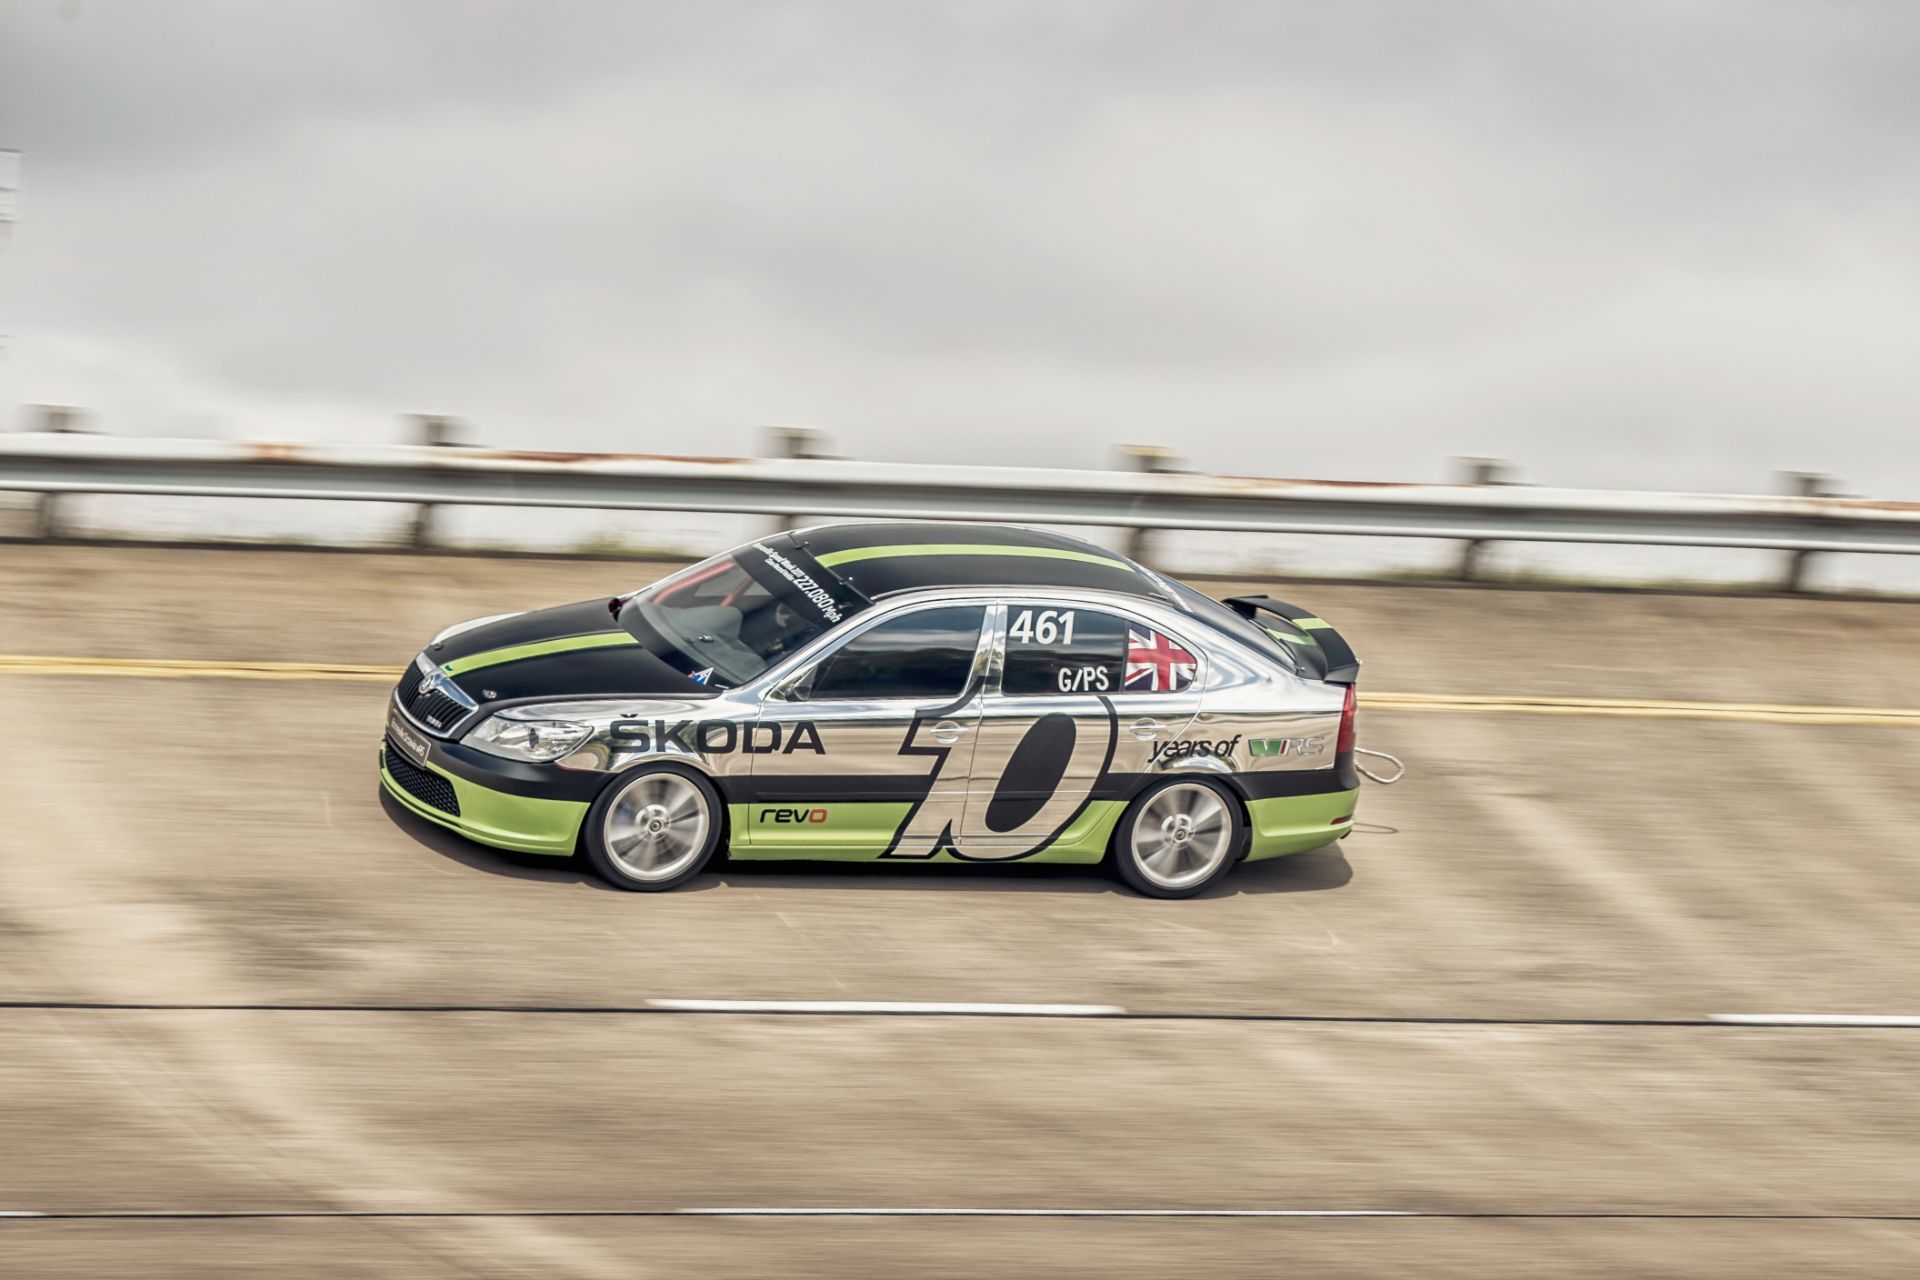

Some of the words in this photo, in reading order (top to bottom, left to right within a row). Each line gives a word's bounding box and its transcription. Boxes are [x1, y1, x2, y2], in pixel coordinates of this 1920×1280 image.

[792, 575, 835, 609] 227.080
[1009, 610, 1075, 645] 461
[1058, 665, 1109, 692] G/PS
[609, 713, 826, 755] ŠKODA
[1147, 738, 1213, 763] years
[1214, 734, 1242, 757] of
[876, 676, 1119, 862] 10
[759, 808, 828, 824] revo
